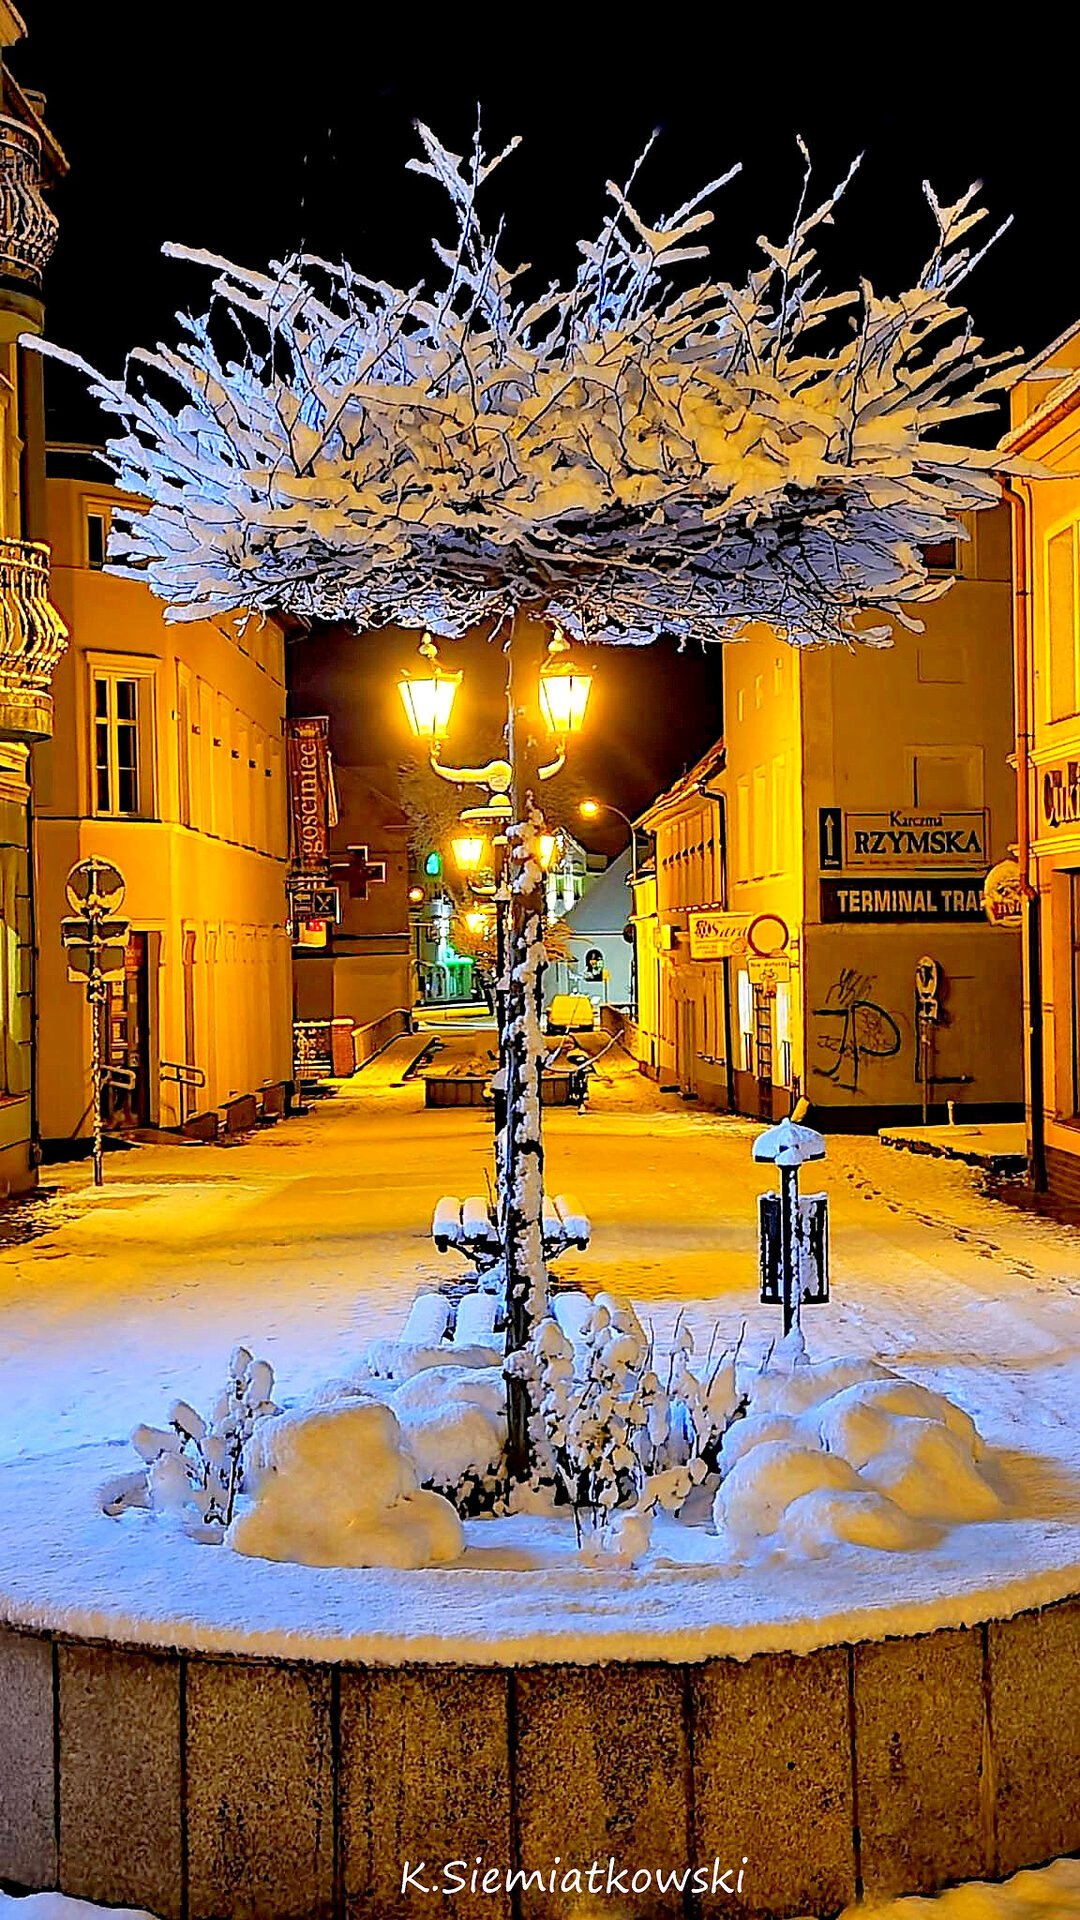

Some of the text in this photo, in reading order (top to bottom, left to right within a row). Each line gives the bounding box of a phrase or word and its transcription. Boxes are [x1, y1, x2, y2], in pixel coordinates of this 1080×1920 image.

[890, 811, 943, 827] Karczma
[854, 830, 982, 854] RZYMSKA
[837, 890, 938, 913] TERMINAL
